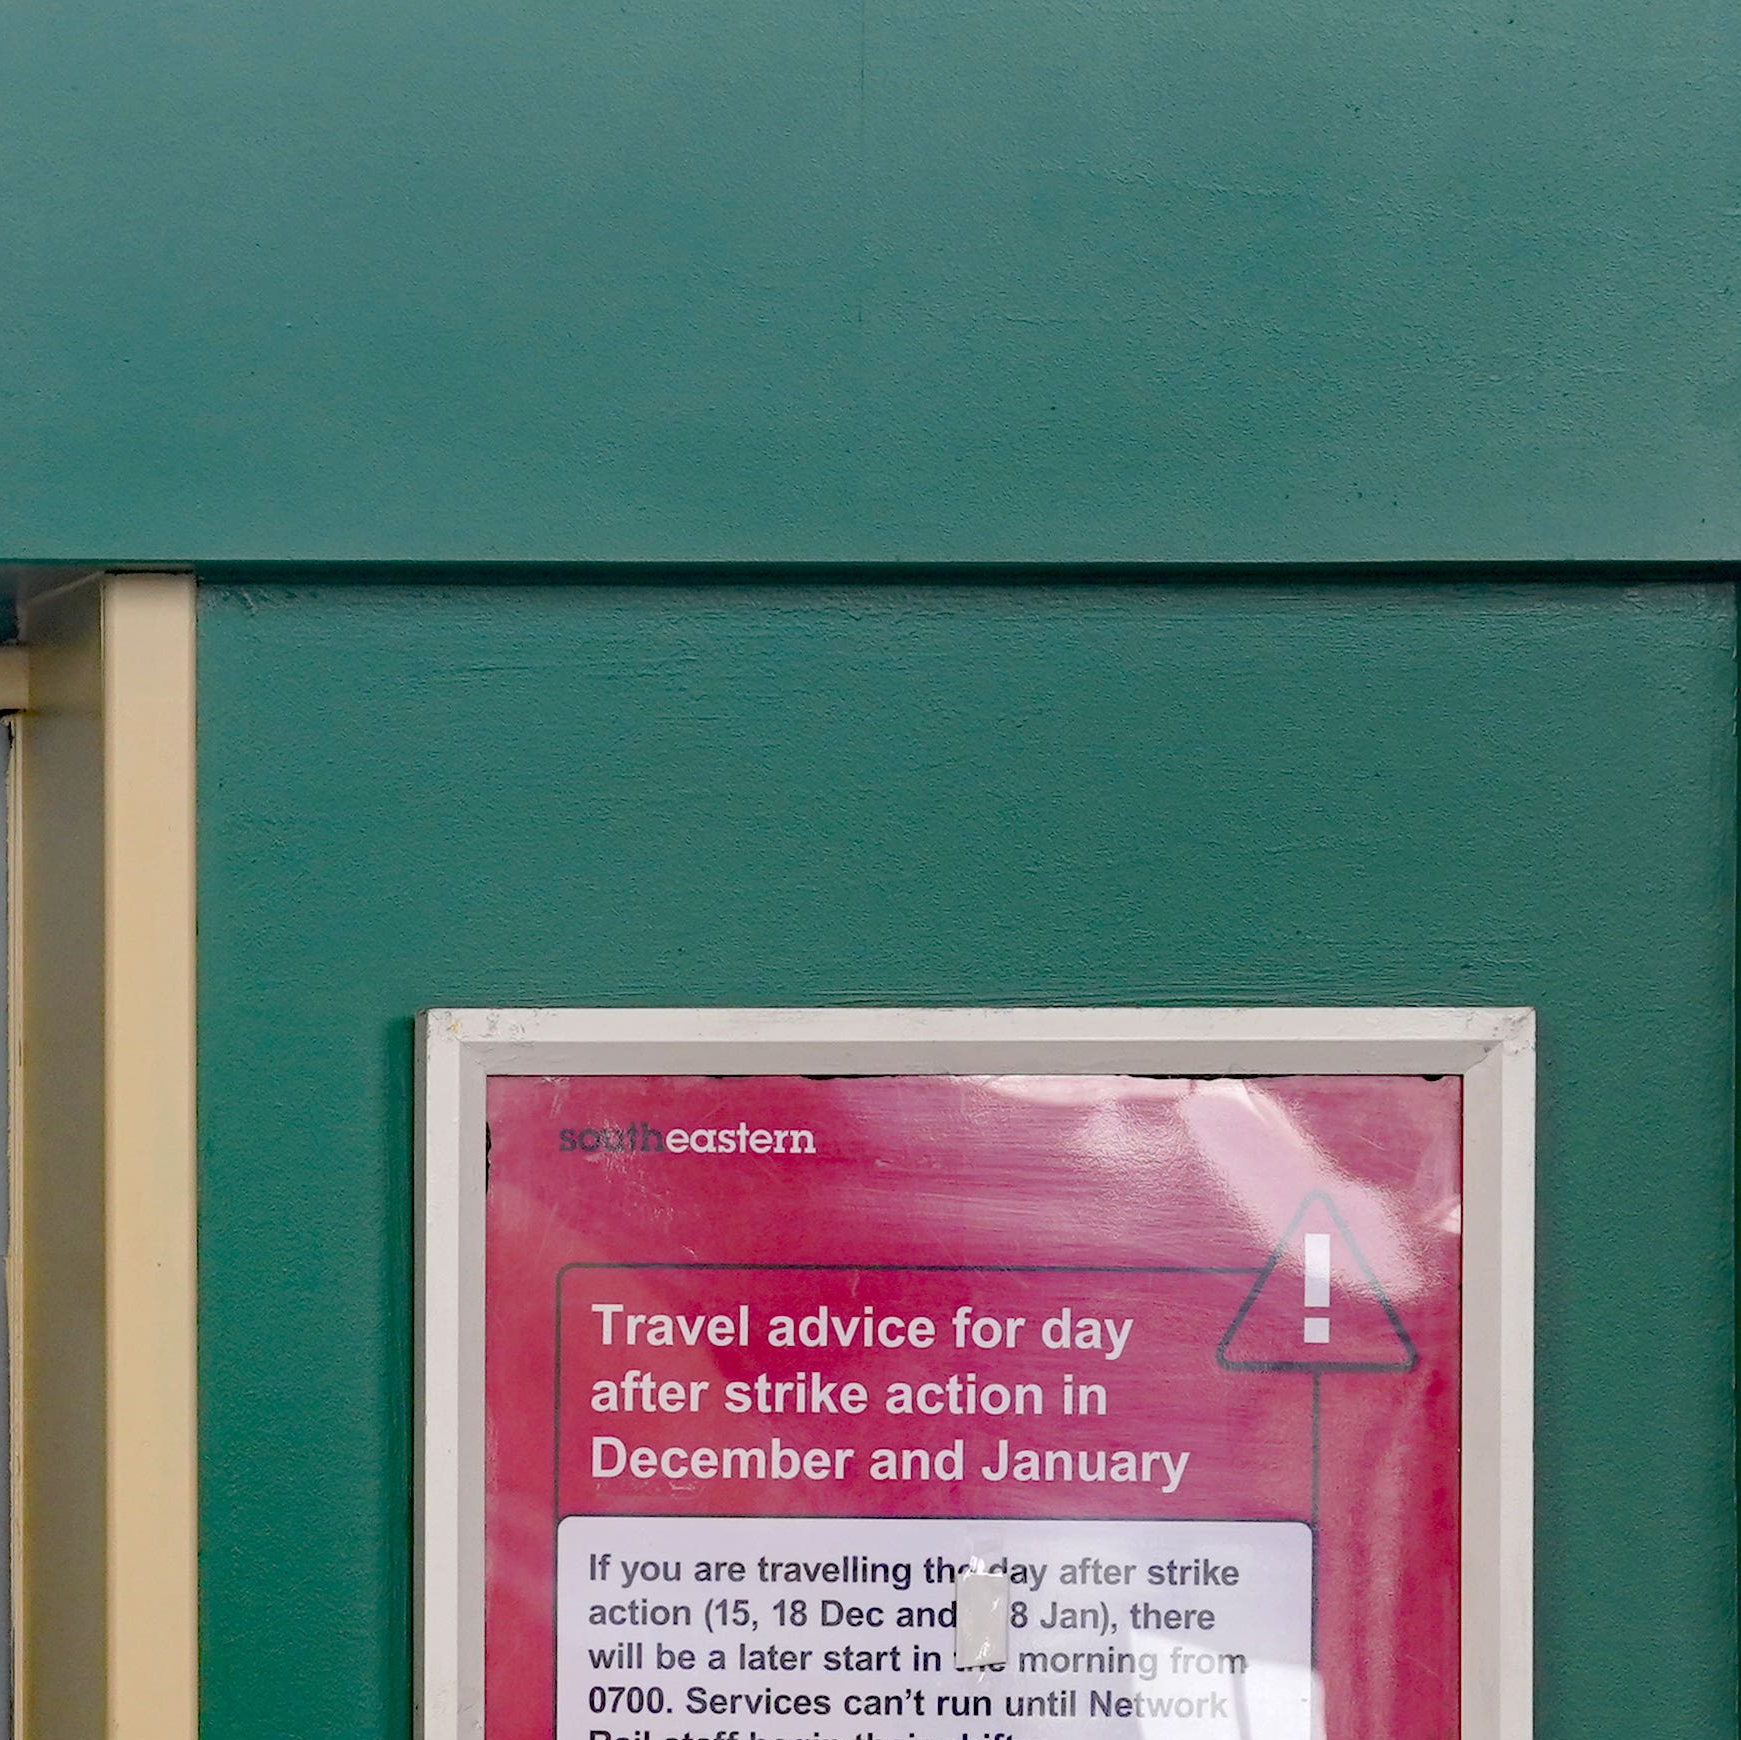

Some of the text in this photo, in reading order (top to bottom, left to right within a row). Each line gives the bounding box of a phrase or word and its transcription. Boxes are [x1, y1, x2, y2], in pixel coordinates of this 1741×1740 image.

[560, 1122, 816, 1154] southeastern
[592, 1304, 1133, 1360] Travel advice for day
[591, 1370, 1105, 1414] after strike action in
[592, 1437, 1189, 1493] December and January
[591, 1554, 611, 1580] If
[621, 1561, 680, 1588] you
[695, 1562, 745, 1582] are
[758, 1556, 911, 1590] travelling
[988, 1557, 1047, 1591] day
[1060, 1558, 1136, 1584] after
[1148, 1559, 1239, 1585] strike
[589, 1599, 690, 1625] action
[705, 1599, 757, 1633] (15,
[773, 1599, 807, 1626] 18
[822, 1600, 884, 1627] Dec
[896, 1600, 957, 1629] and
[1040, 1602, 1117, 1636] Jan),
[1130, 1603, 1214, 1630] there
[588, 1642, 642, 1669] will
[657, 1643, 695, 1670] be
[708, 1650, 725, 1670] a
[740, 1643, 813, 1671] later
[823, 1645, 901, 1672] start
[914, 1645, 941, 1671] in
[1019, 1646, 1156, 1680] morning
[1170, 1647, 1247, 1674] from
[589, 1686, 1228, 1719] 0700. Services can't run until Network
